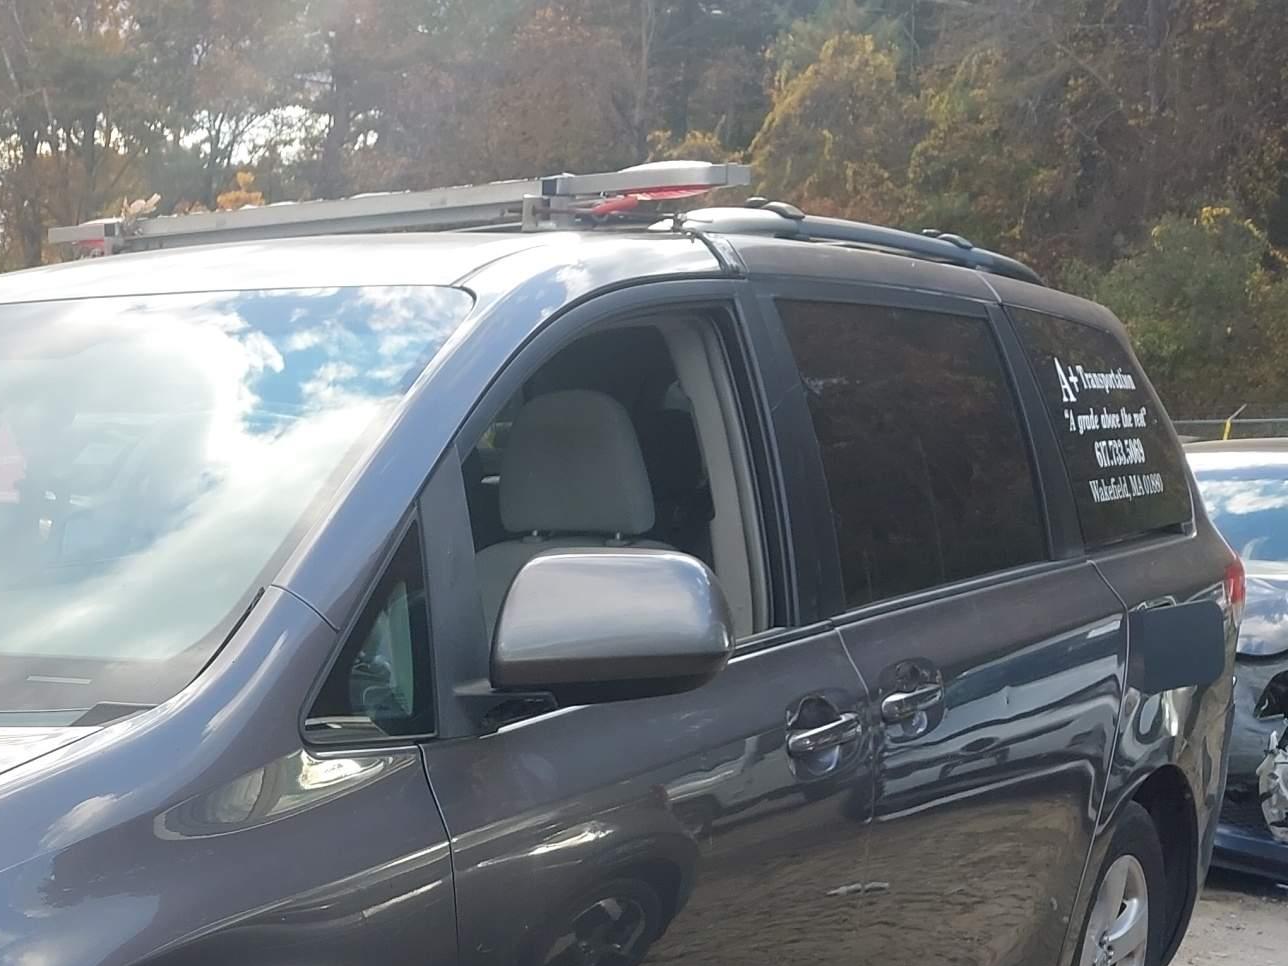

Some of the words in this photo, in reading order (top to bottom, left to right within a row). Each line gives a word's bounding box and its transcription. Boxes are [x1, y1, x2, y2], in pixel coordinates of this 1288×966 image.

[1054, 357, 1079, 402] A+
[1076, 365, 1136, 394] Transportation
[1077, 408, 1099, 435] grade
[1100, 407, 1121, 429] above
[1120, 406, 1134, 428] the
[1089, 475, 1132, 502] Wakefield,
[1128, 474, 1145, 497] MA
[1143, 472, 1163, 494] 01880
